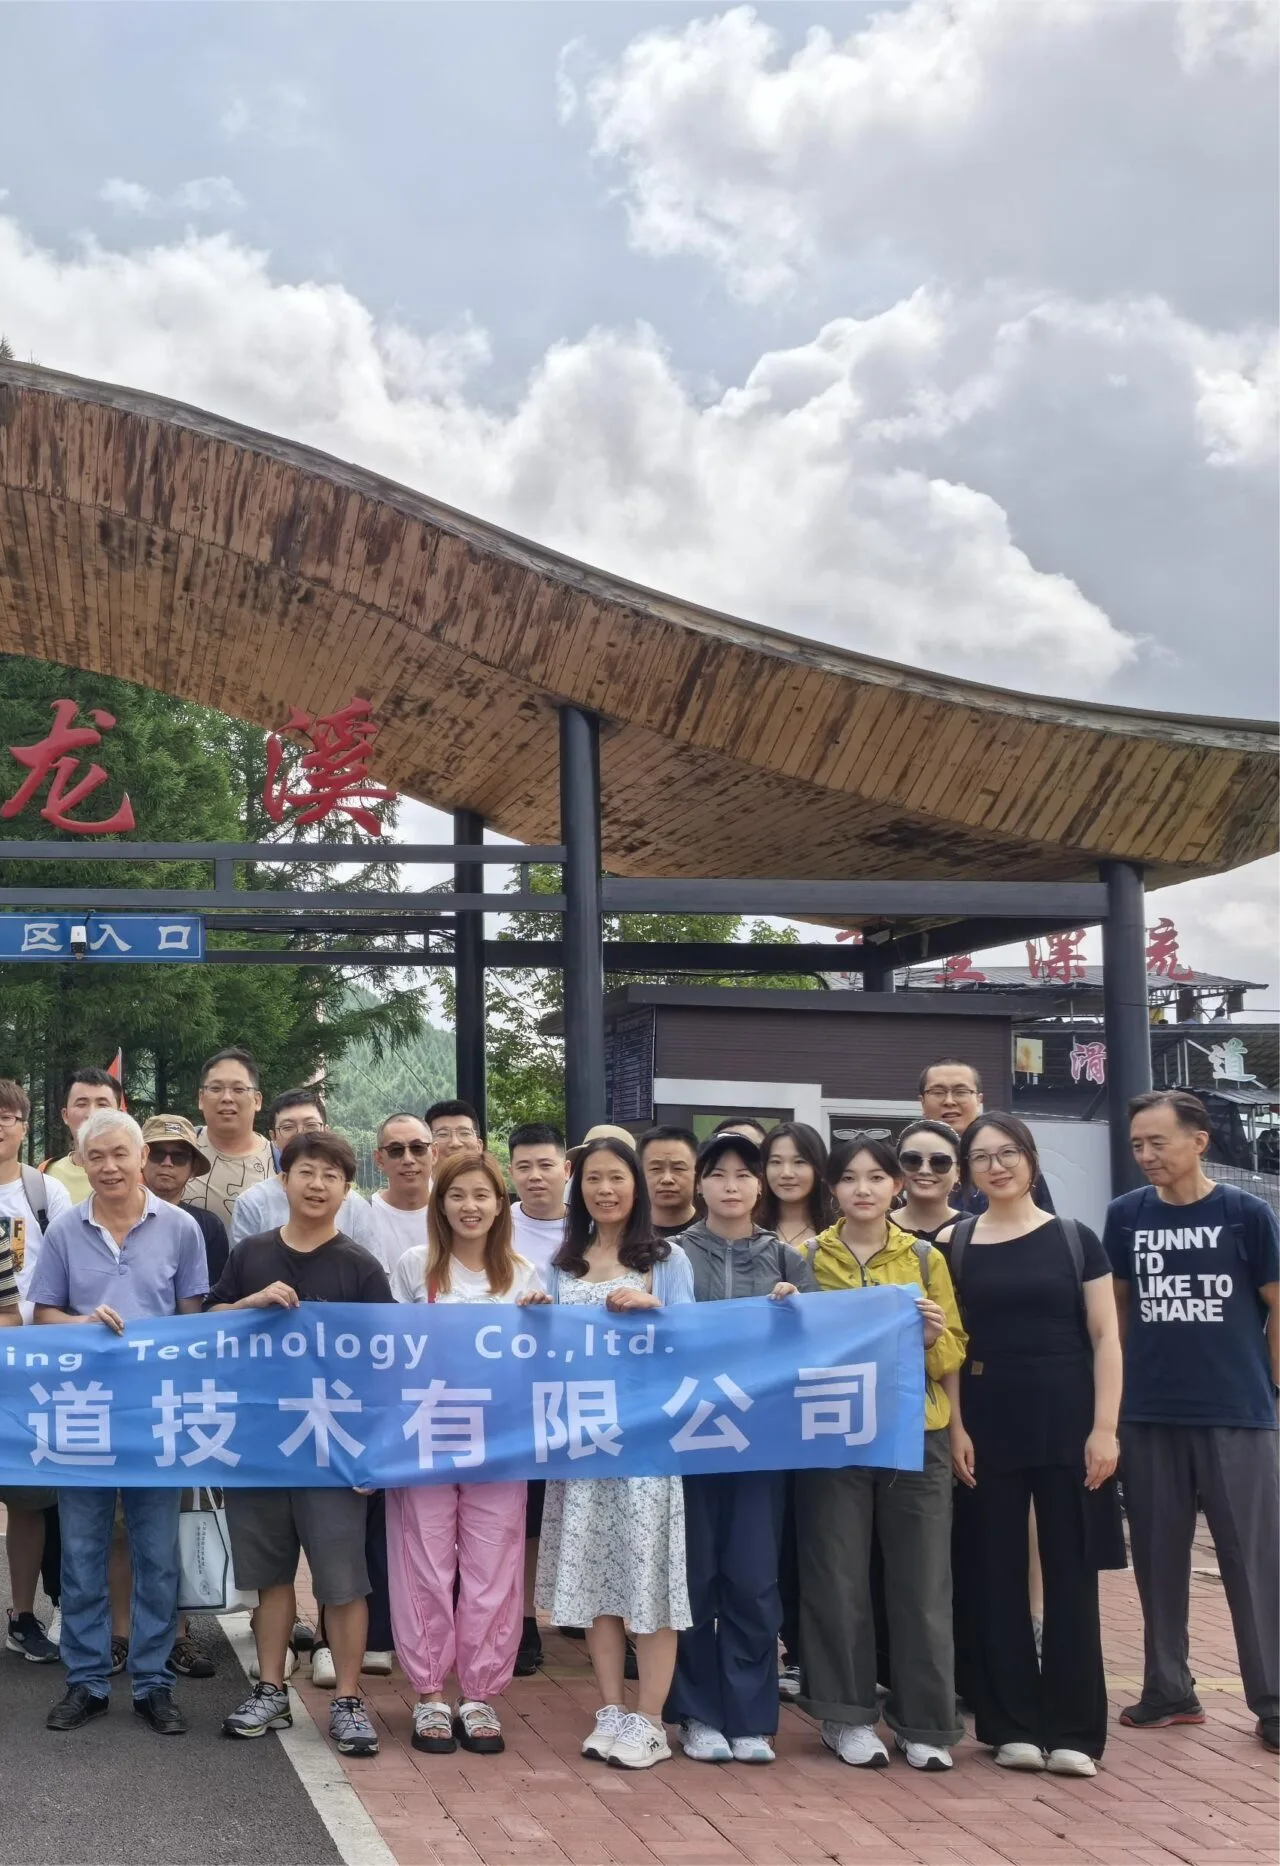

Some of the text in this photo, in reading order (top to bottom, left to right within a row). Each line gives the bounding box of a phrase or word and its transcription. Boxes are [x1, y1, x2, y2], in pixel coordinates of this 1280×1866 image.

[1133, 1226, 1223, 1251] FUNNY
[1135, 1252, 1164, 1275] I'D
[1138, 1274, 1233, 1299] LIKE TO
[1140, 1298, 1224, 1323] SHARE
[128, 1322, 429, 1370] Technology
